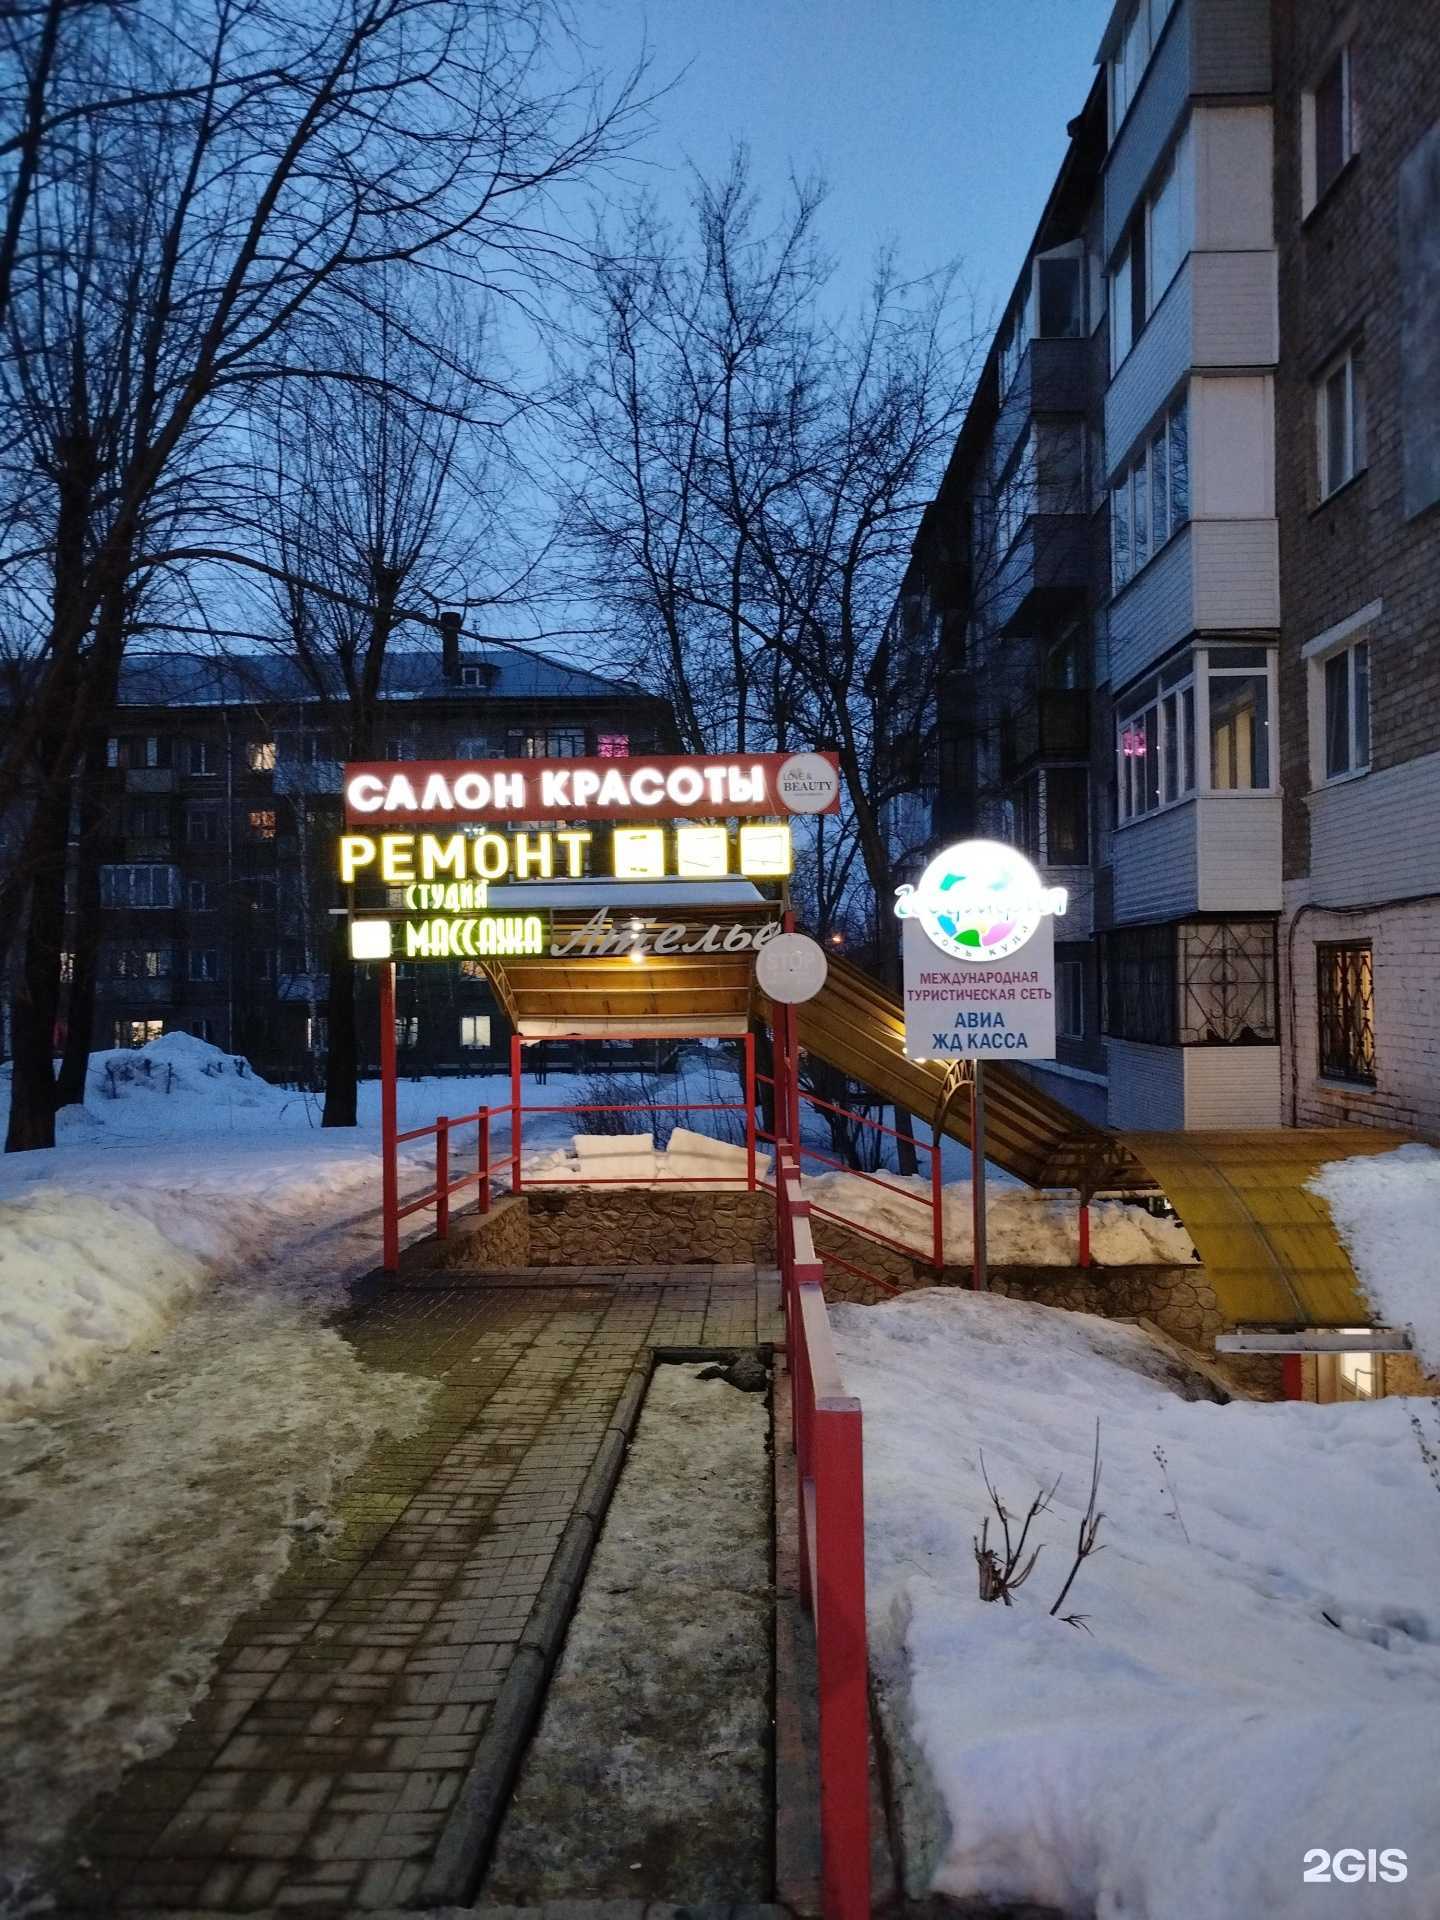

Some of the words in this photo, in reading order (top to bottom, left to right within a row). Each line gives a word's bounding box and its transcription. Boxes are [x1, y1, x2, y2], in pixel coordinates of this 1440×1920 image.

[347, 772, 525, 813] САЛОН
[541, 764, 766, 807] КРАСОТЫ
[783, 781, 832, 792] BEAUTY
[339, 831, 593, 884] РЕМОНТ
[406, 882, 490, 912] СТУДИЯ
[406, 917, 543, 957] МАССАЖА
[551, 906, 782, 956] Ателье
[919, 971, 1039, 985] МЕЖДУНАРОДНАЯ
[907, 988, 1016, 1001] ТУРИСТИЧЕСКАЯ
[1020, 988, 1052, 1000] СЕТЬ
[954, 1011, 1005, 1028] АВИА
[932, 1033, 963, 1051] ЖД
[967, 1033, 1028, 1049] КАССА
